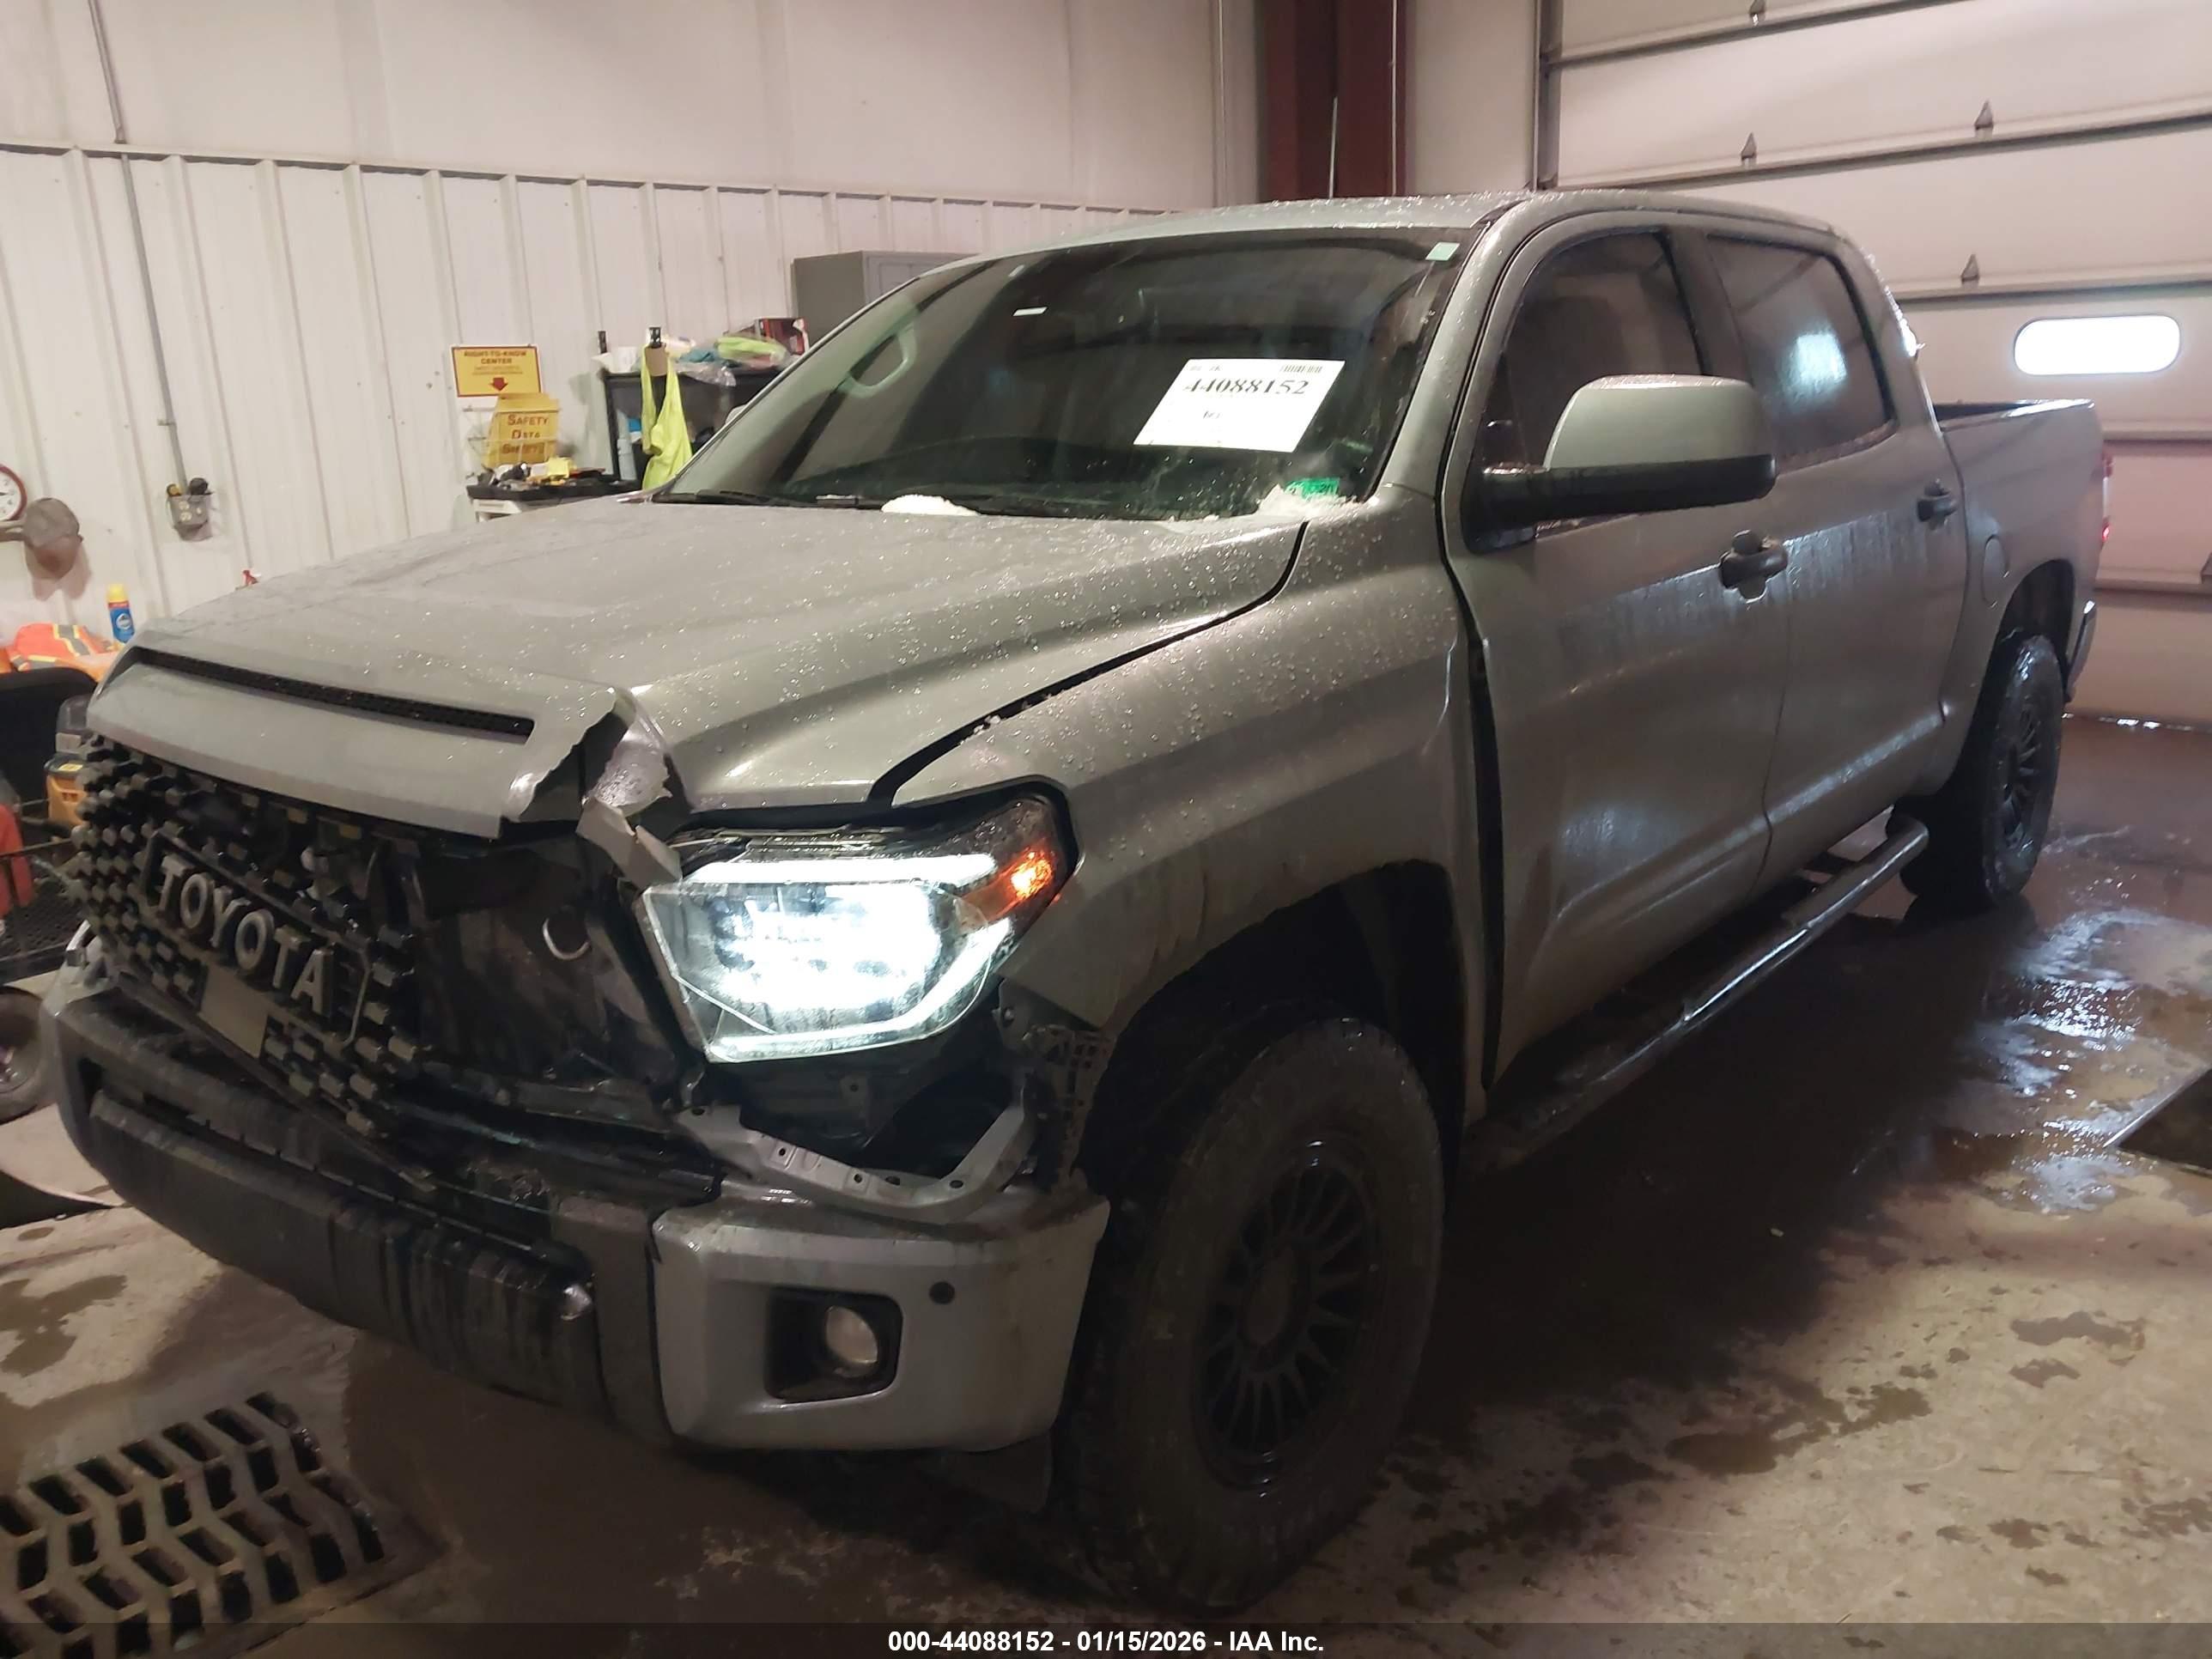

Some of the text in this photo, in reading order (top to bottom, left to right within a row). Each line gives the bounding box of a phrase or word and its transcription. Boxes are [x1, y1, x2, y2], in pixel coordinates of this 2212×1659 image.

[1183, 378, 1310, 395] 44088152
[507, 414, 550, 426] SAFETY
[158, 854, 333, 1016] TOYOTA
